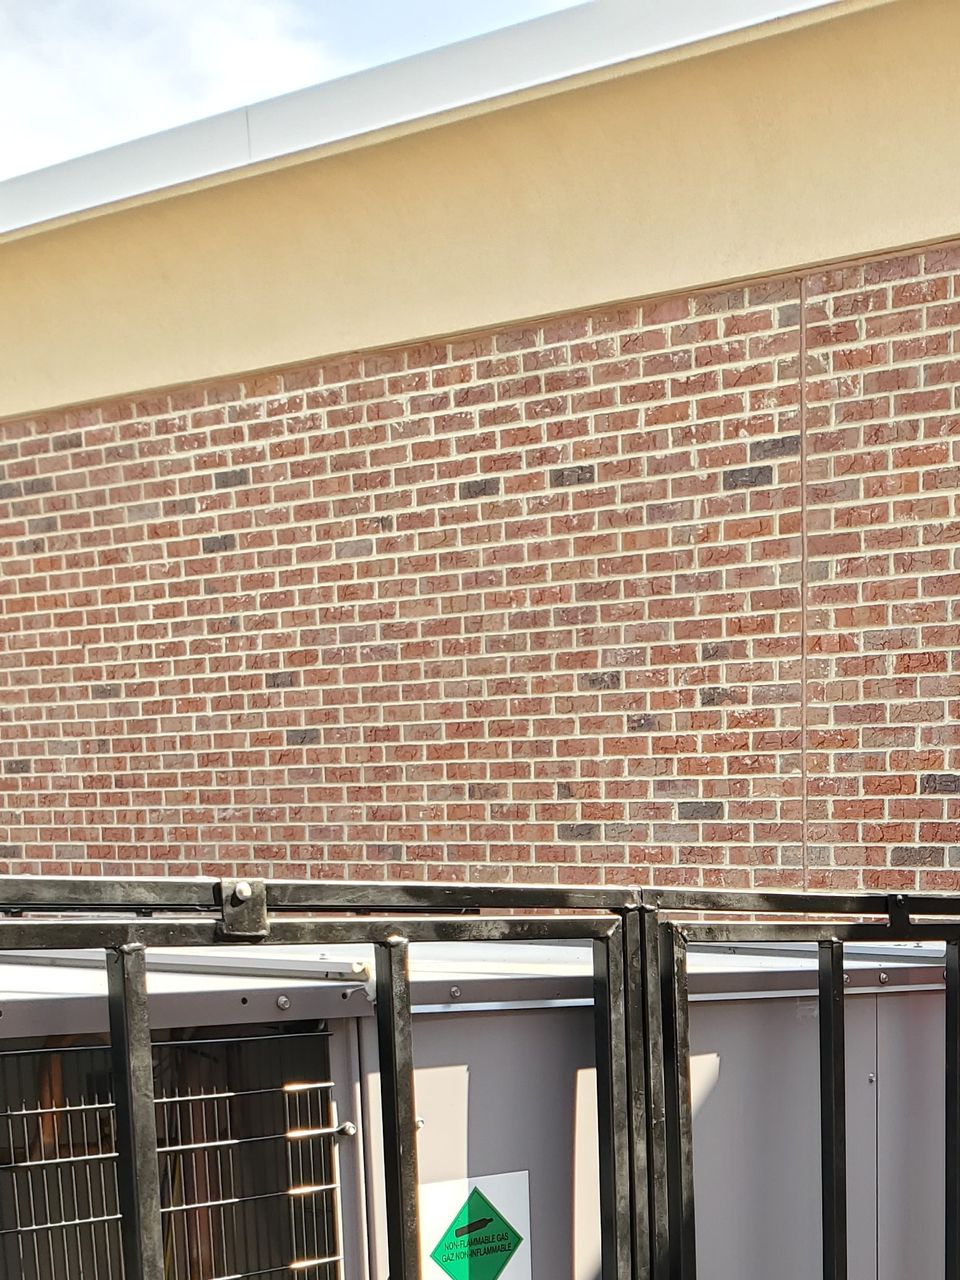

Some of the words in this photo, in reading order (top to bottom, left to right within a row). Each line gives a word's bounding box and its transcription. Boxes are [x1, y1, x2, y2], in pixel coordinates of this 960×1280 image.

[444, 1233, 496, 1251] NON-FLAMMABLE
[496, 1232, 509, 1242] GAS
[442, 1253, 455, 1263] GAZ
[455, 1242, 512, 1261] NON-INFLAMMABLE
